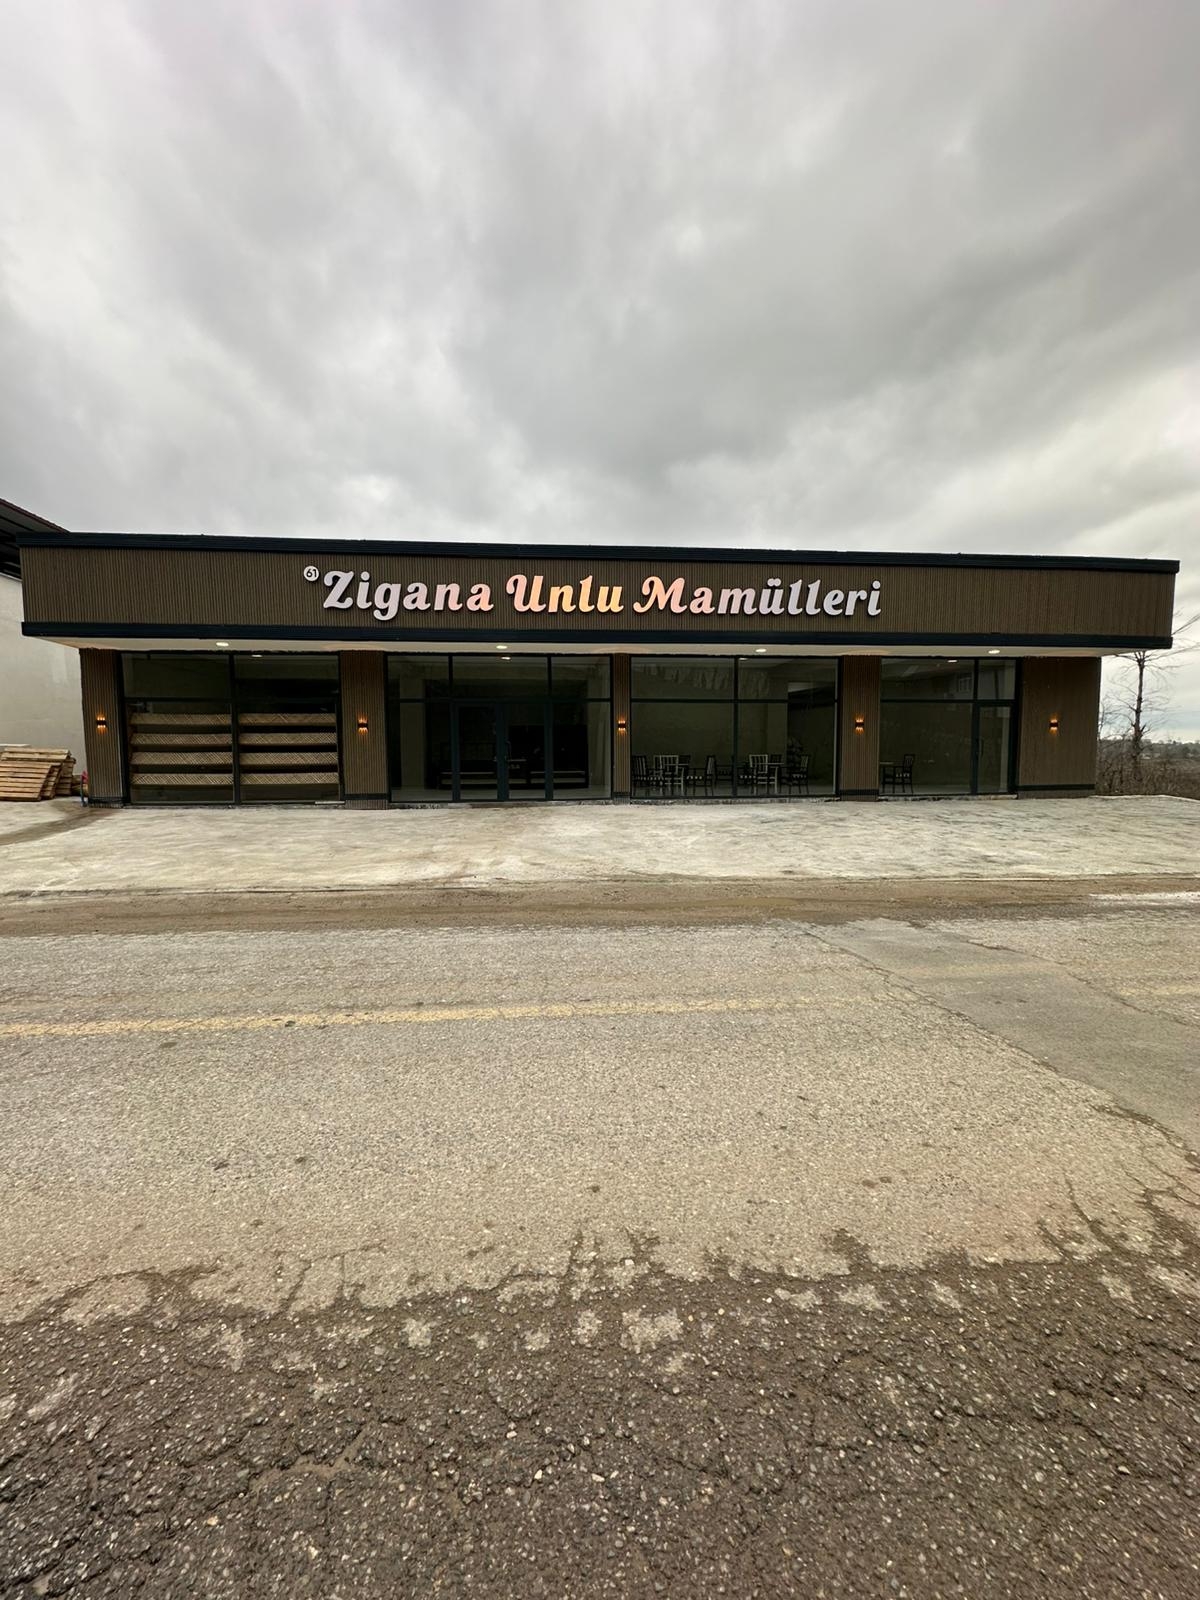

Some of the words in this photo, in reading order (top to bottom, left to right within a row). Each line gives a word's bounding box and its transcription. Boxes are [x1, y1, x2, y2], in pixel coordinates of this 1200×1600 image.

[305, 568, 317, 578] 61
[323, 571, 494, 621] Zigana
[506, 575, 624, 614] Unlu
[633, 576, 882, 616] Mamülleri
